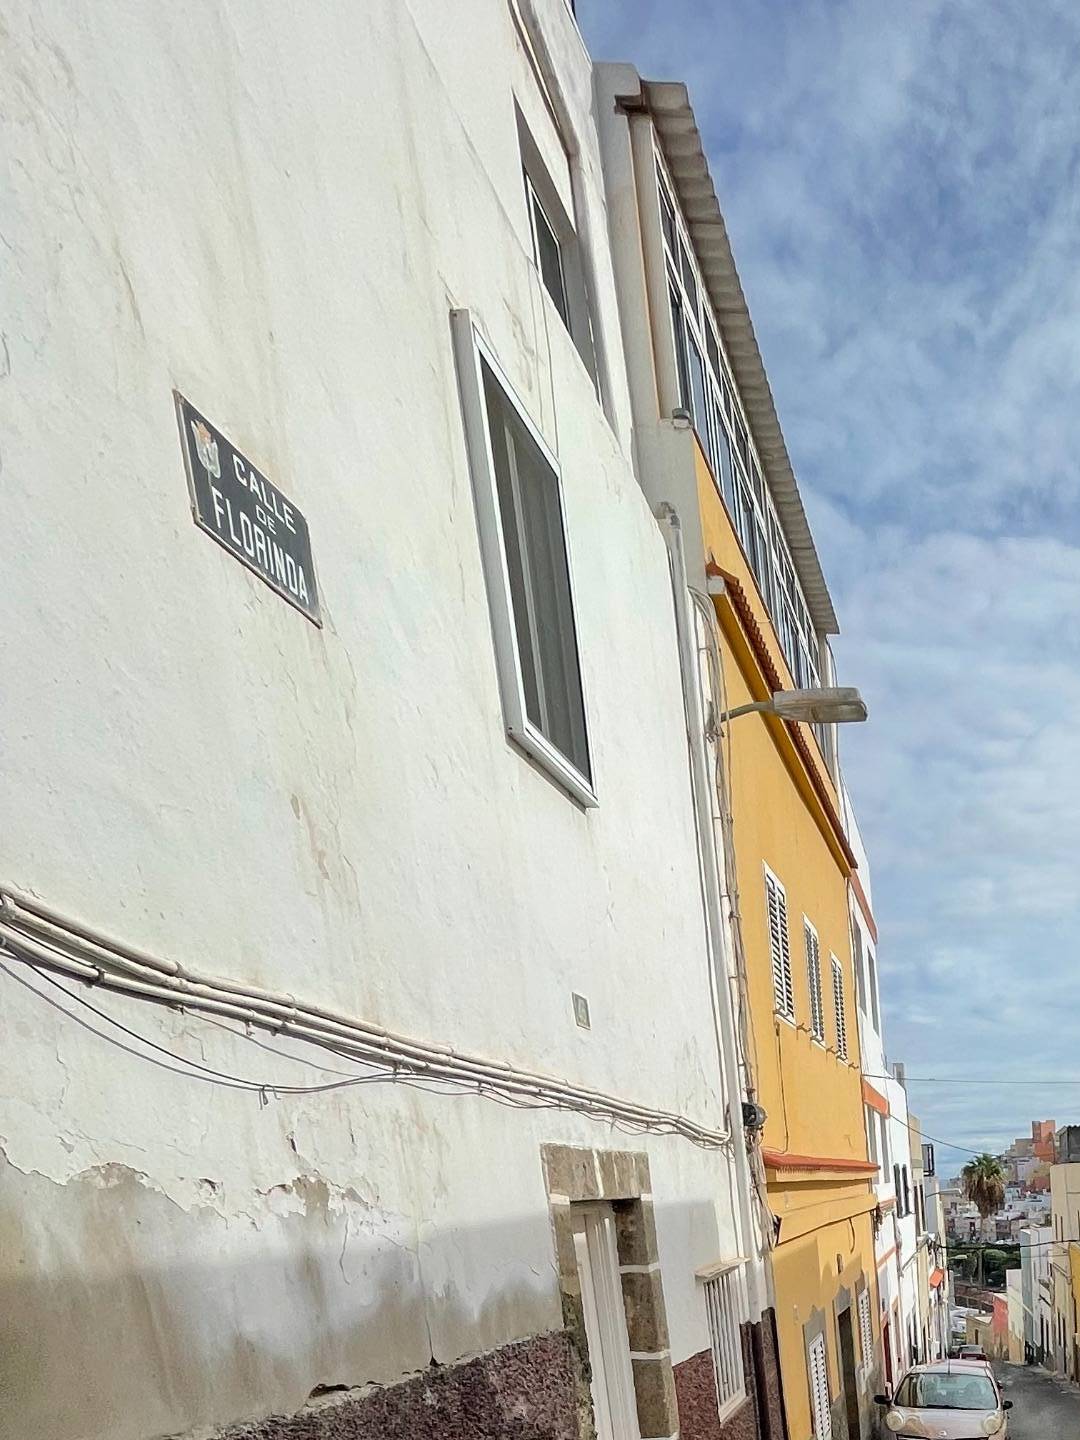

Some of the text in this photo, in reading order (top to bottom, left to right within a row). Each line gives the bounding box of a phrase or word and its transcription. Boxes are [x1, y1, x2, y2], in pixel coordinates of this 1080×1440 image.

[232, 453, 297, 535] CALLE
[255, 503, 277, 535] DE
[211, 485, 309, 605] FLORINDA
